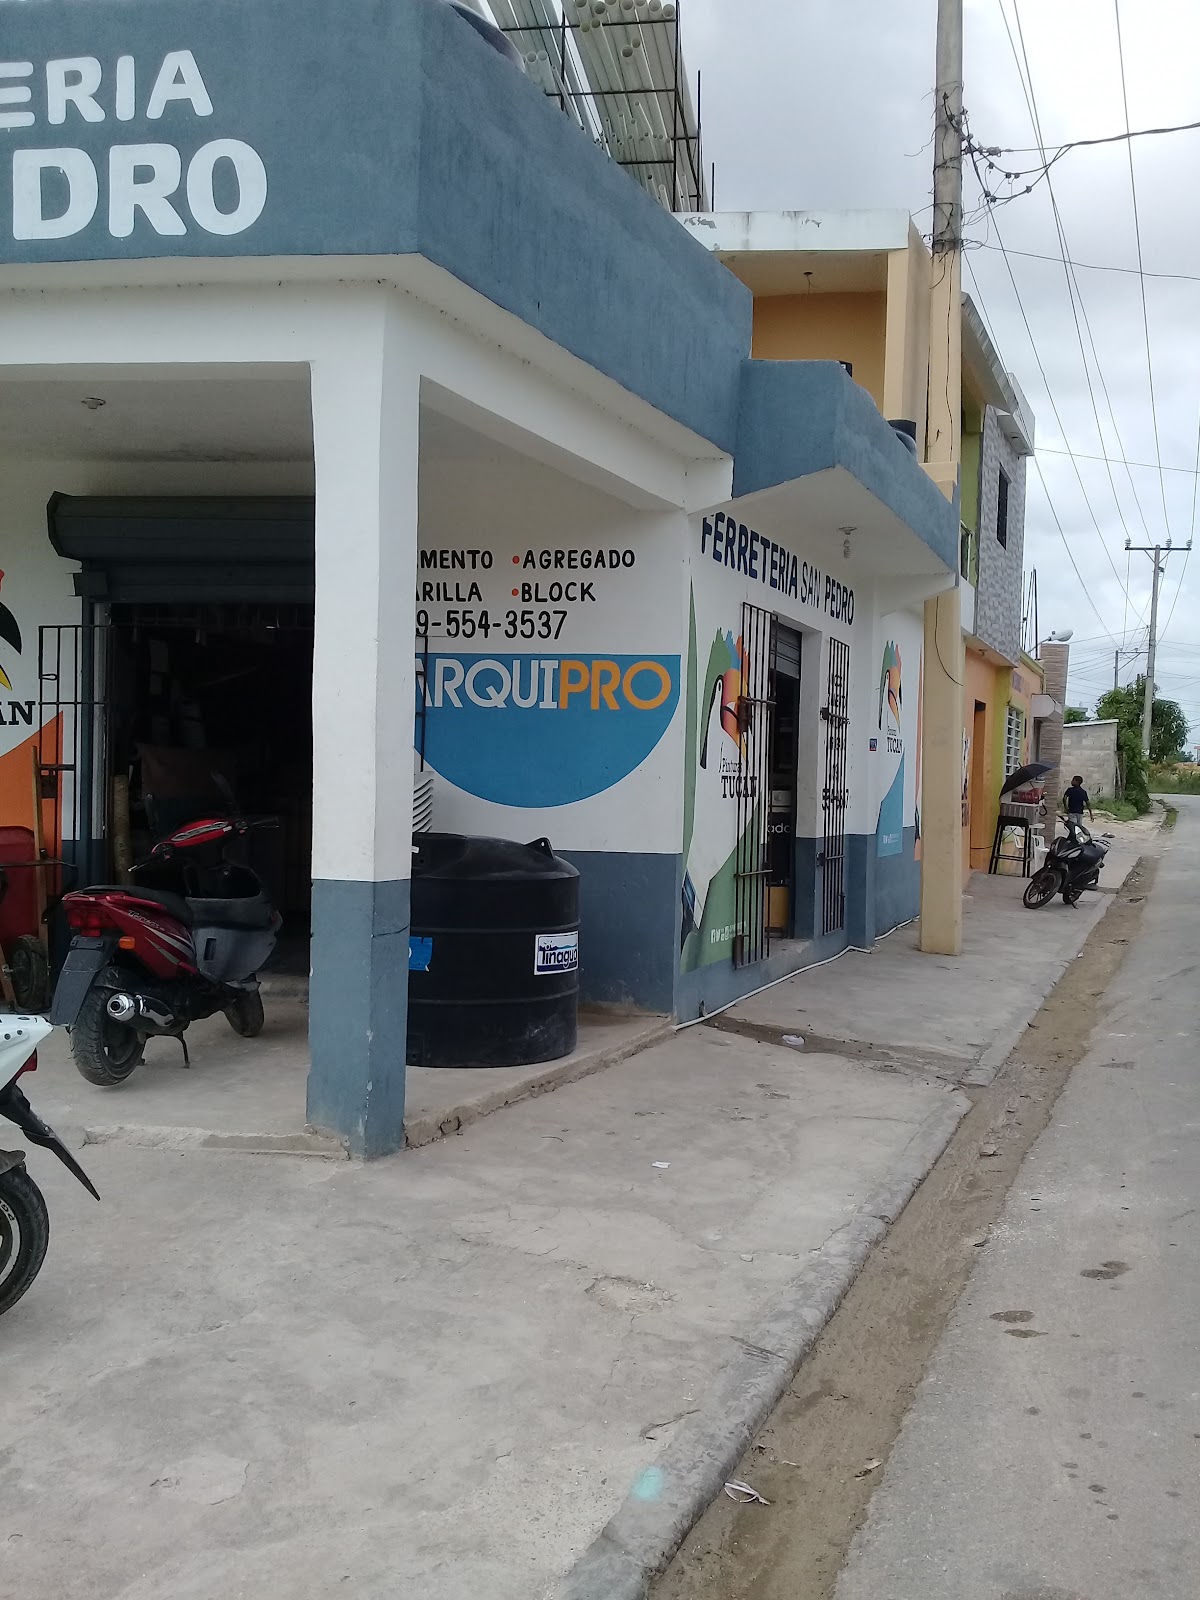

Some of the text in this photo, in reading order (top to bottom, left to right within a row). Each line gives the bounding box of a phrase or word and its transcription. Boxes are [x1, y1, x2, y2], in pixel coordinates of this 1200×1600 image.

[12, 138, 268, 241] DRO
[416, 549, 635, 569] MENTO AGREGADO
[701, 511, 855, 626] FERRETERIA SAN PEDRO
[521, 582, 596, 602] BLOCK
